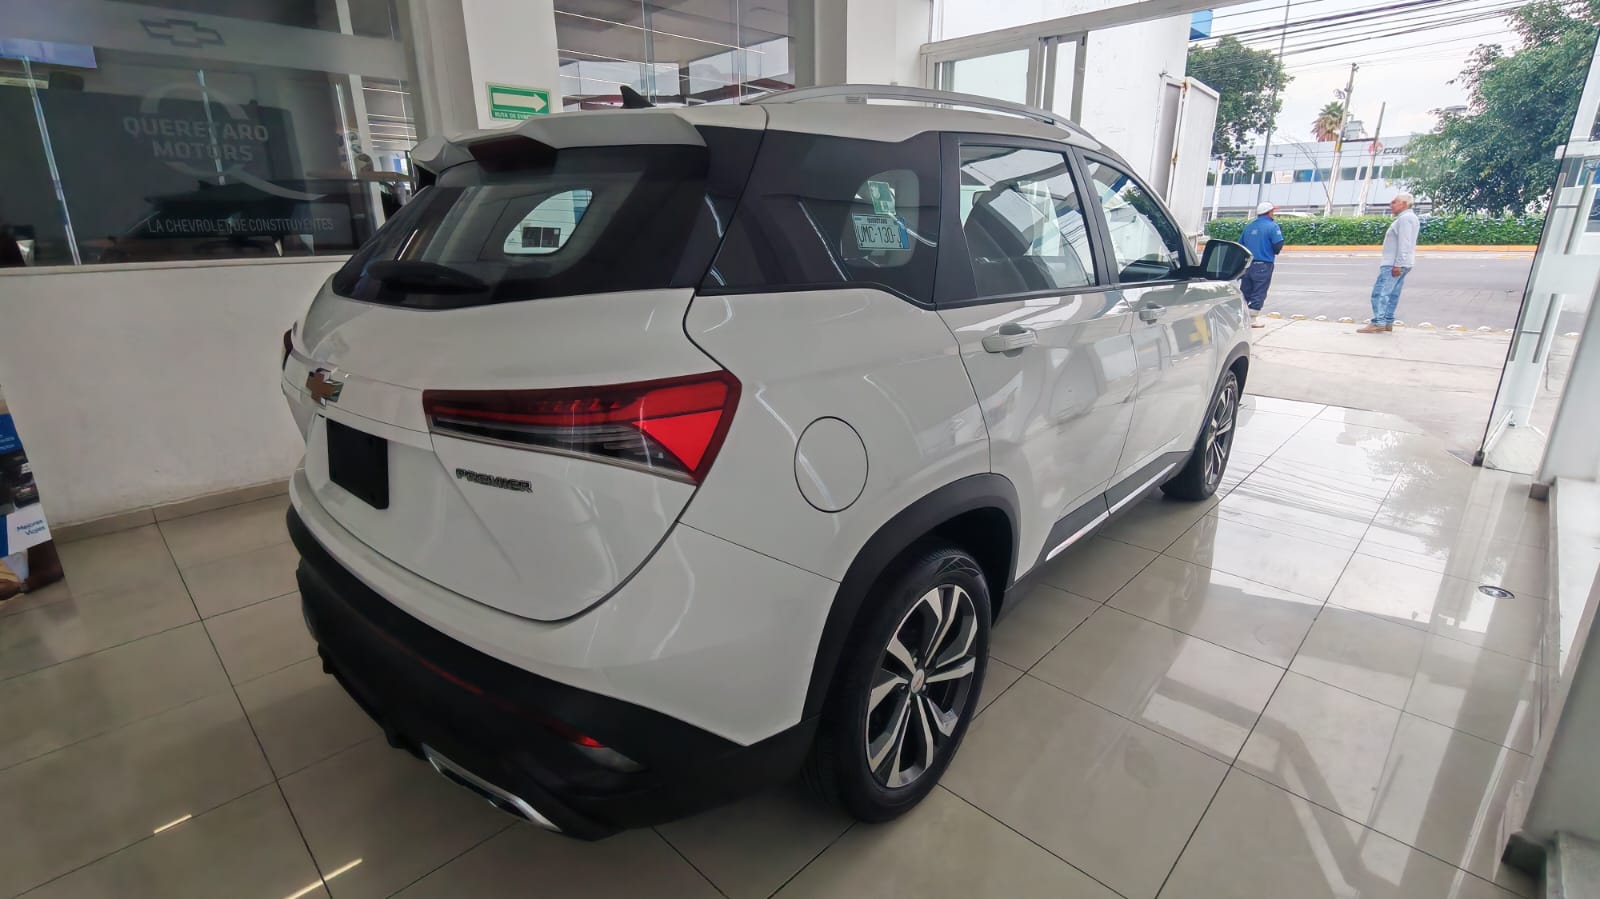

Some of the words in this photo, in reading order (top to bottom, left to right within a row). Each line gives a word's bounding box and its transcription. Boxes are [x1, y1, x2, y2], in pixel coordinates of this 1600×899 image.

[151, 141, 254, 161] MOTORS
[147, 217, 165, 232] LA
[165, 217, 231, 233] CHEVROLET
[232, 217, 248, 232] DE
[248, 217, 335, 232] CONSTITUYENTES
[455, 467, 533, 494] PREMIER
